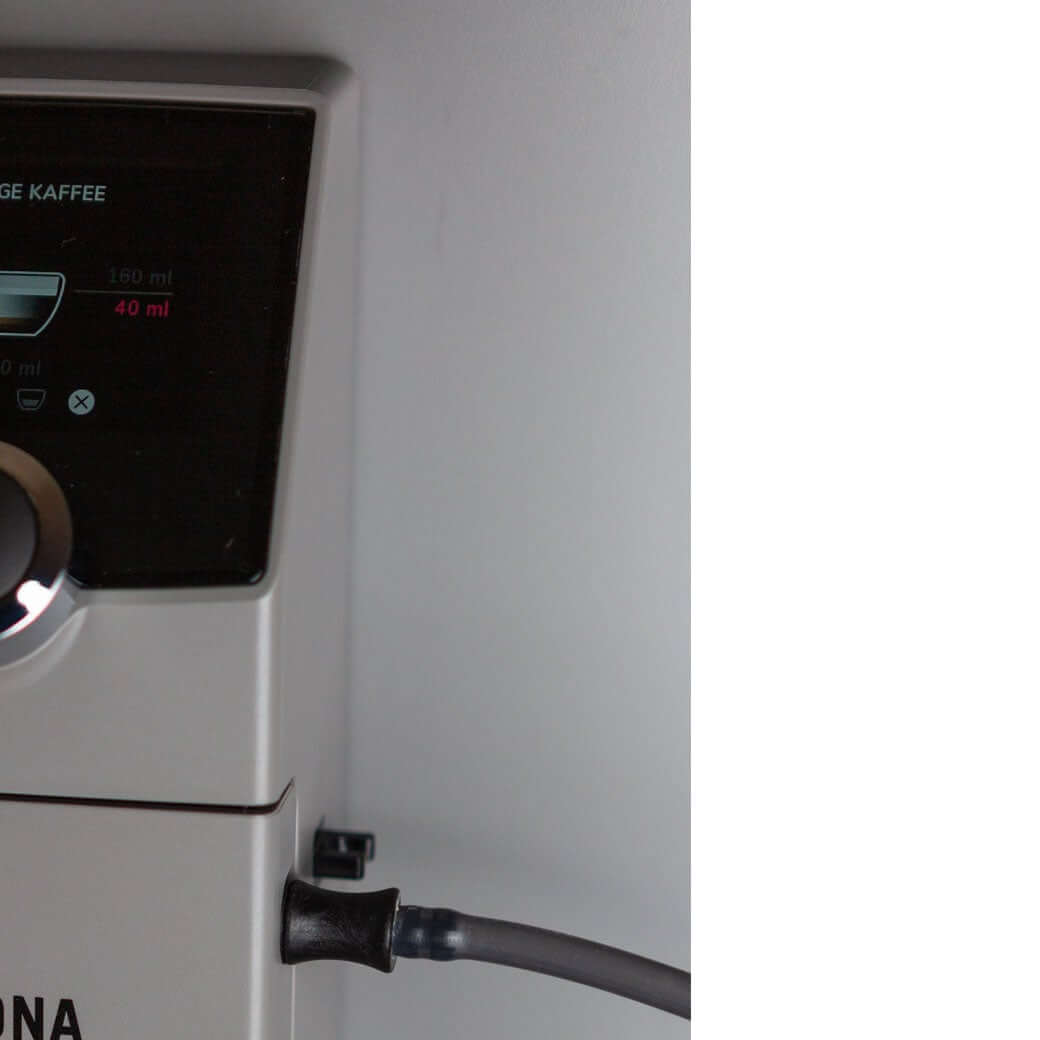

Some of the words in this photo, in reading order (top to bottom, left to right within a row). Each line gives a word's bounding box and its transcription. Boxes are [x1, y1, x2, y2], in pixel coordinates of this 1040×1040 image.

[29, 183, 107, 201] KAFFEE
[149, 268, 173, 286] ml
[114, 299, 140, 317] 40
[145, 300, 169, 318] ml
[18, 359, 41, 376] ml
